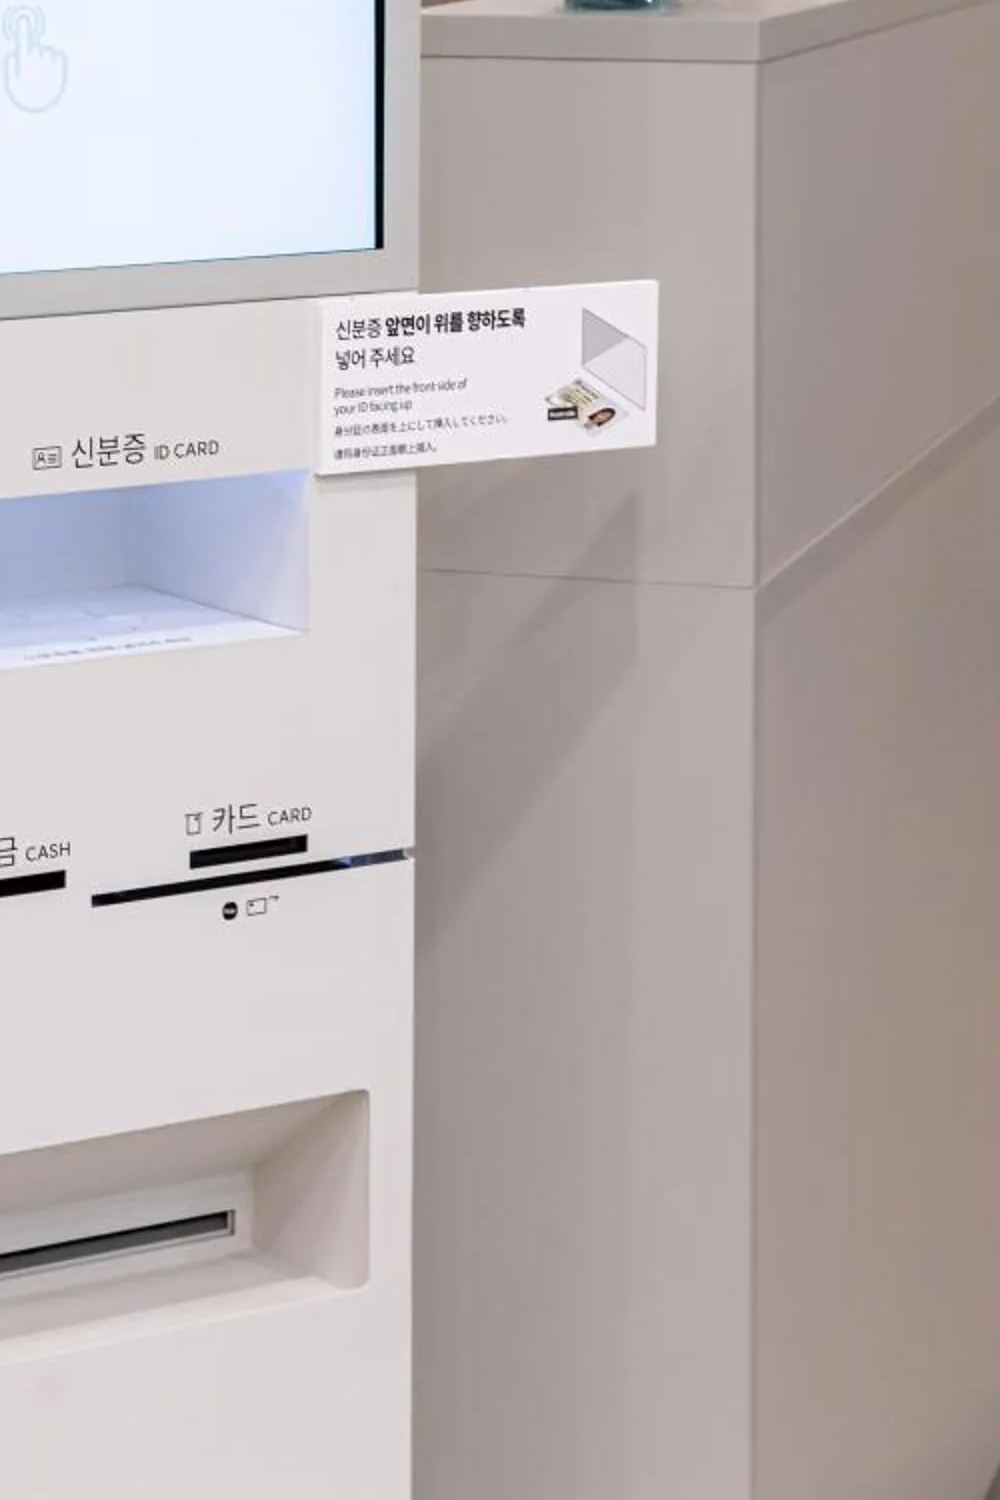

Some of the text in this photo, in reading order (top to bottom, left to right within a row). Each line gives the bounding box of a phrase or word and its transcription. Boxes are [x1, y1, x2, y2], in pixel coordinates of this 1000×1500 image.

[336, 307, 526, 341] 신분증 앞면이 위를 향하도록
[370, 345, 415, 368] 주세요
[71, 433, 219, 469] 신분증 ID CARD
[212, 803, 312, 834] 카드 CARD
[25, 842, 71, 862] CASH
